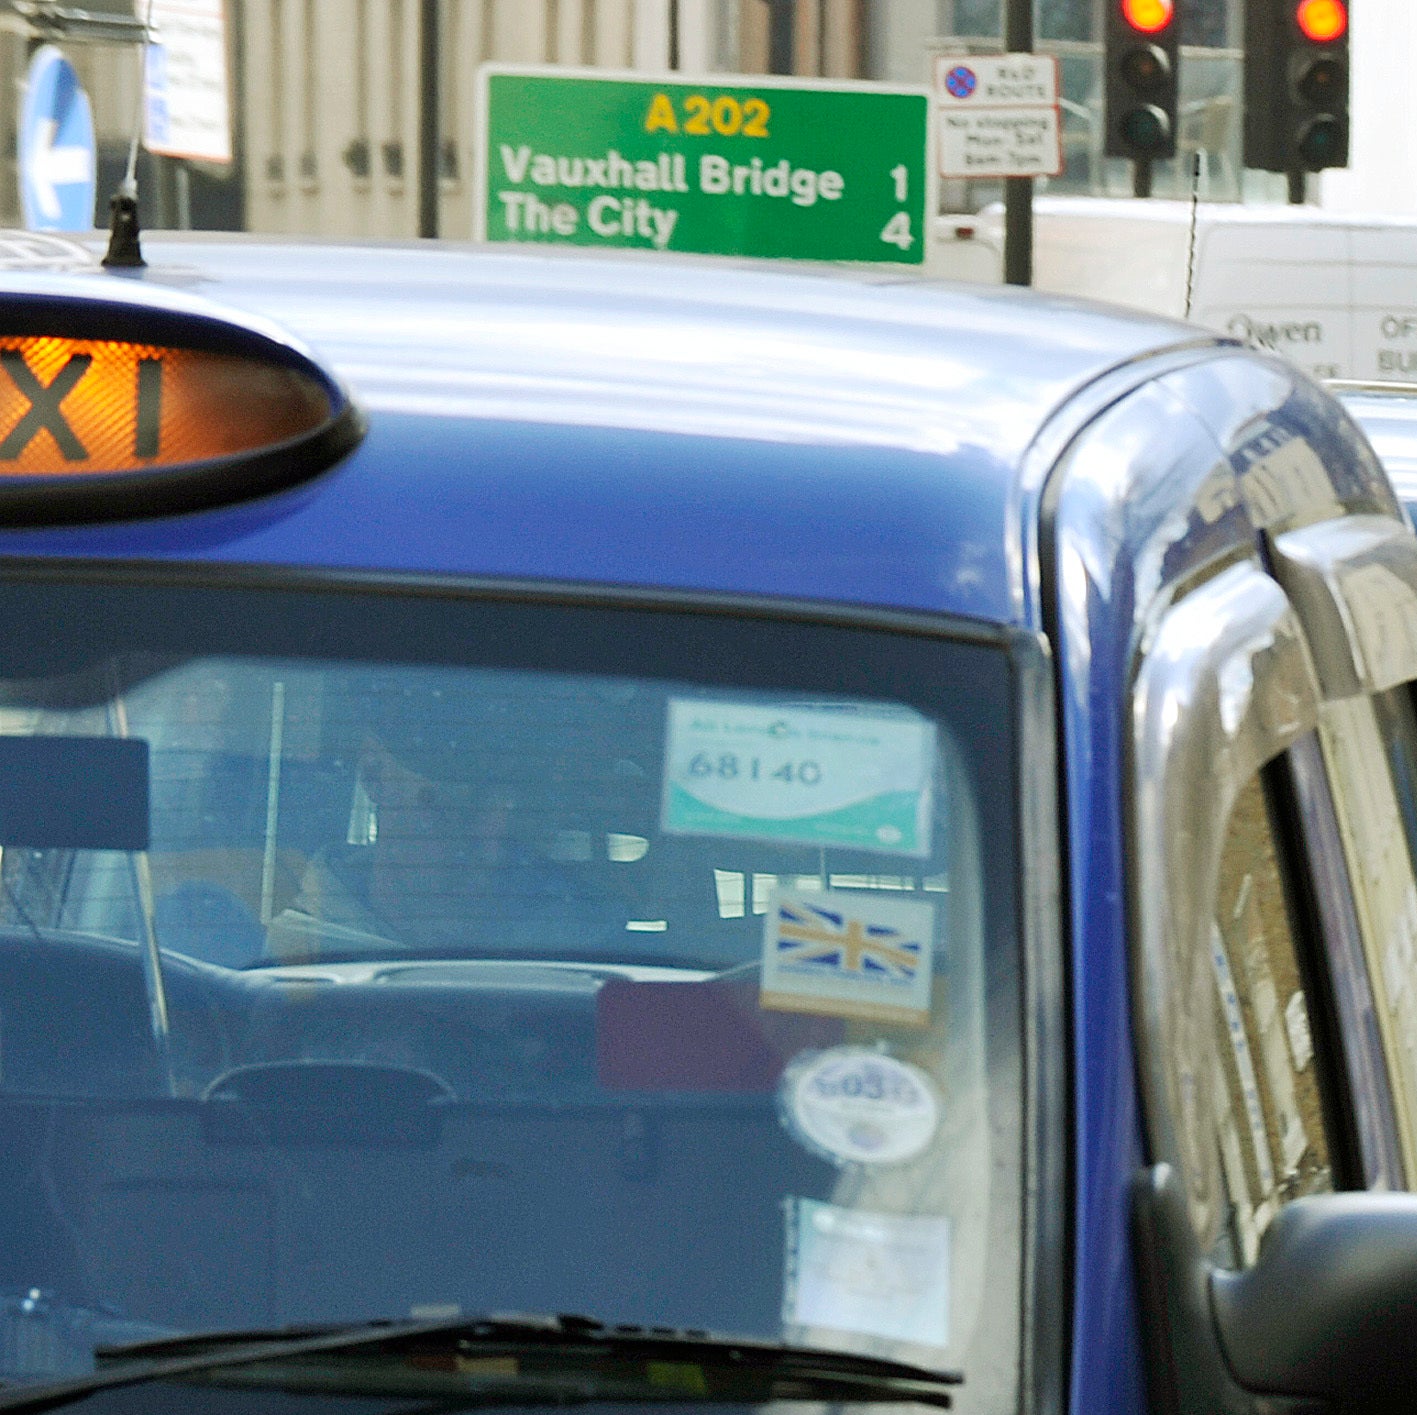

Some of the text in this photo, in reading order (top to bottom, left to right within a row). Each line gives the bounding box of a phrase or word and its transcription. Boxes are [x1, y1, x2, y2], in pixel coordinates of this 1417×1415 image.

[500, 145, 908, 207] Vauxhall Bridge 1
[500, 191, 915, 251] The City 4
[688, 752, 822, 786] 68140
